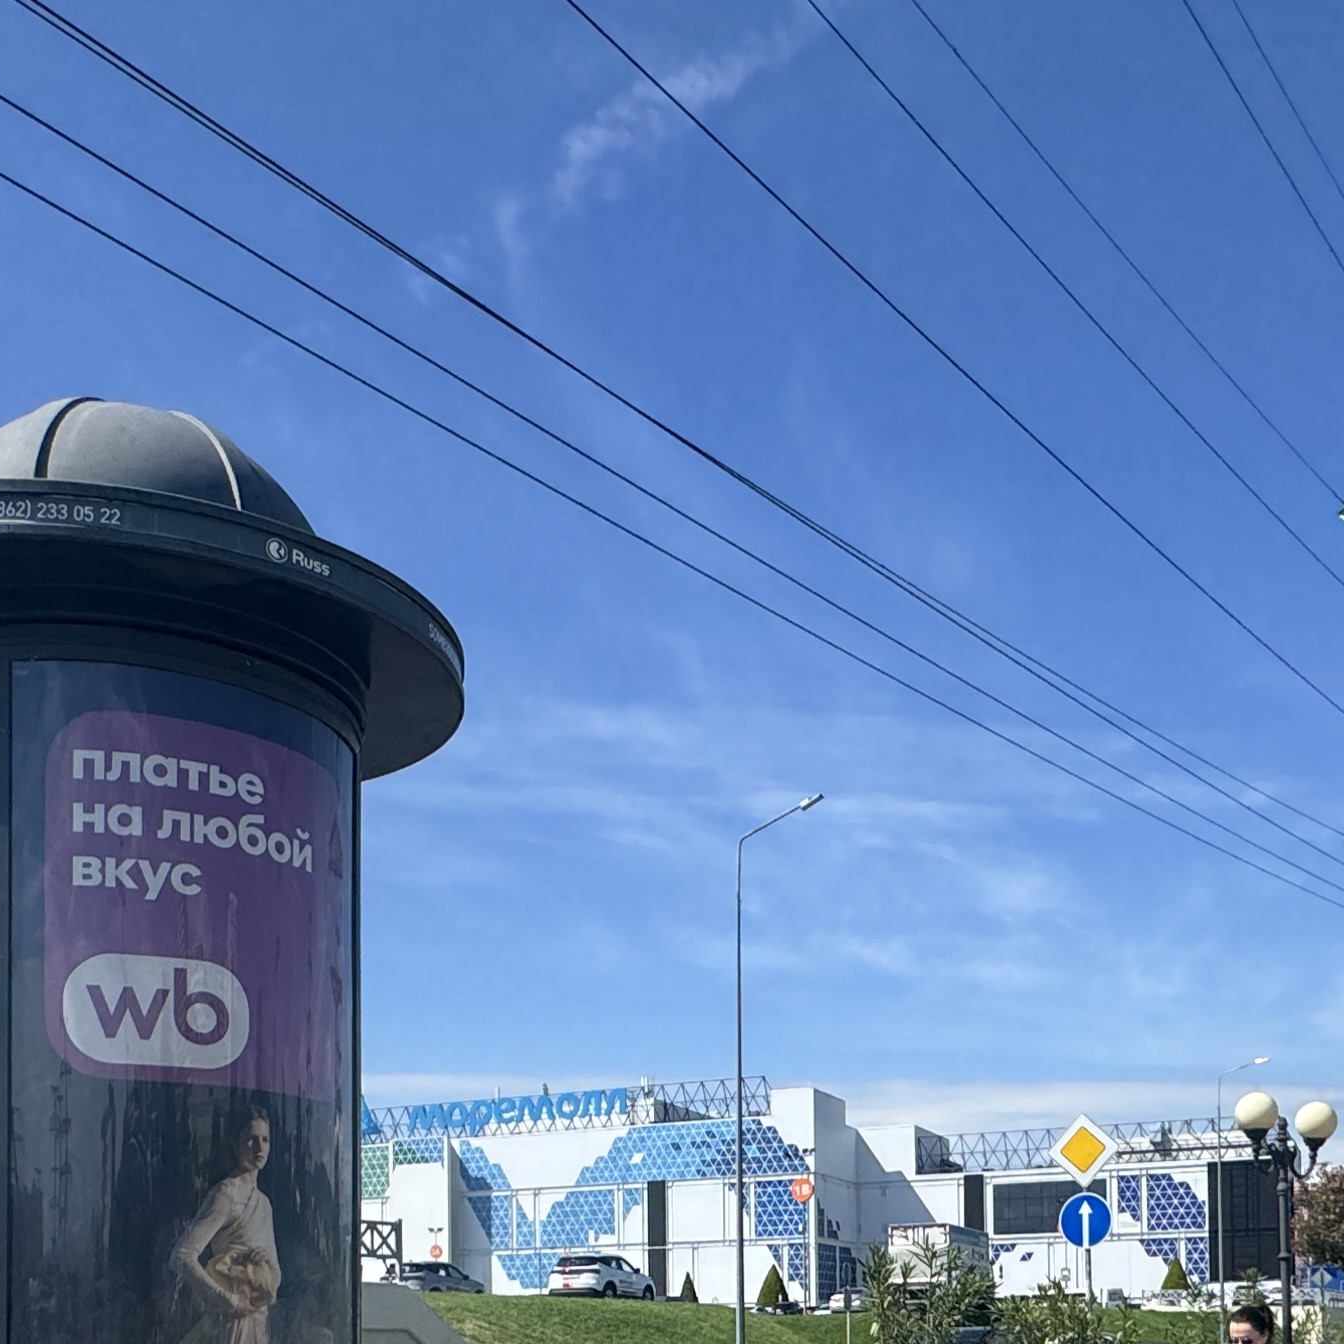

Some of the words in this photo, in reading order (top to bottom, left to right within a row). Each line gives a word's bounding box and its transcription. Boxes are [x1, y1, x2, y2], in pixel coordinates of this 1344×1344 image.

[36, 501, 69, 520] 233
[73, 504, 95, 523] 05
[100, 507, 122, 526] 22
[292, 548, 331, 577] Russ
[71, 748, 265, 805] платье
[71, 801, 143, 837] на
[157, 809, 314, 874] любой
[71, 854, 203, 901] вкус
[85, 967, 231, 1046] wb
